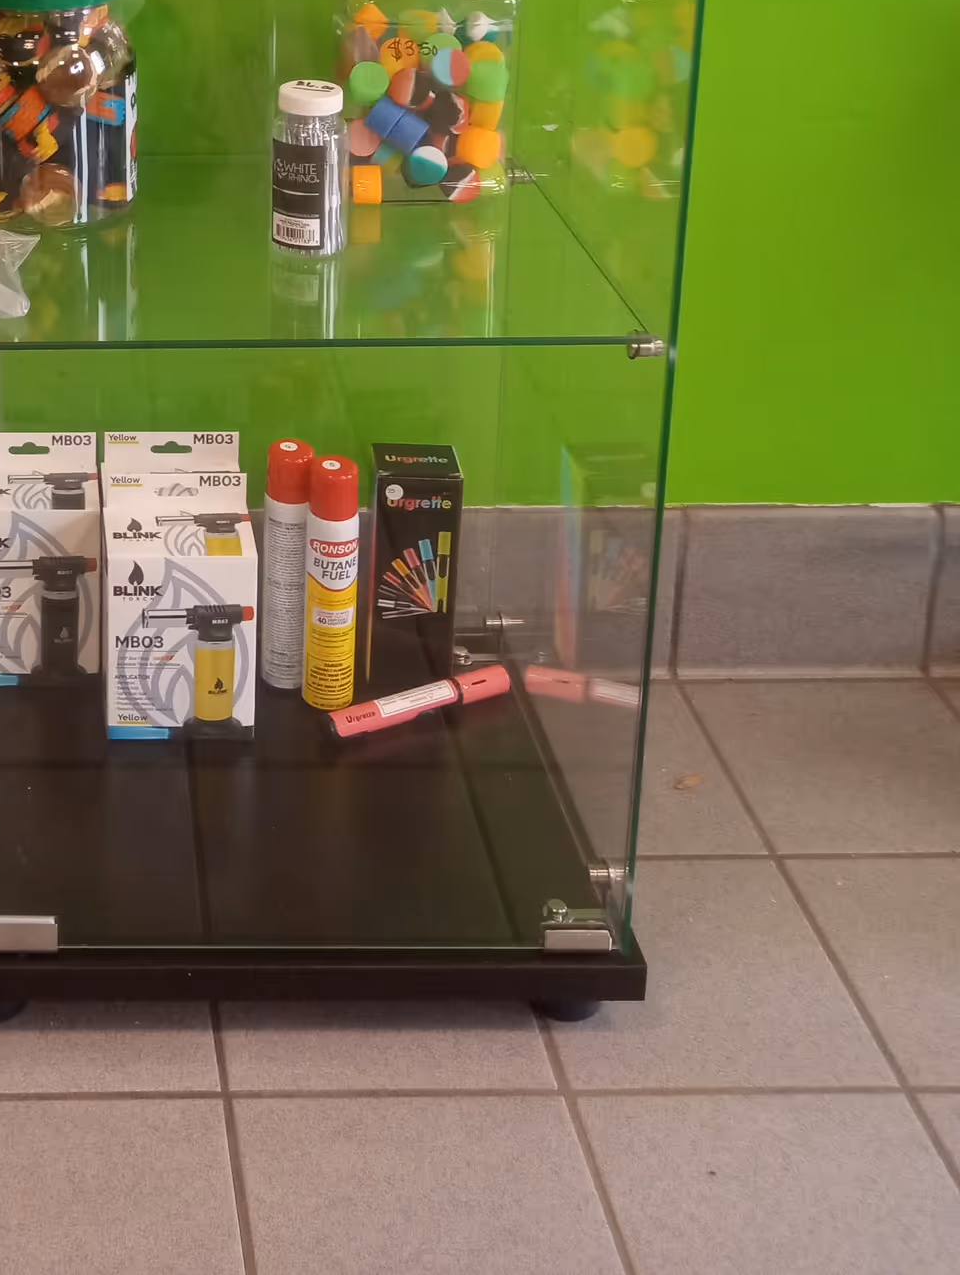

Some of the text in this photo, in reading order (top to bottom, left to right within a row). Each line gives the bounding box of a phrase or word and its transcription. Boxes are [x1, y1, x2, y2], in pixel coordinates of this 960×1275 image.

[284, 163, 317, 175] WHITE
[385, 454, 448, 463] Urgrette
[111, 476, 140, 484] Yellow
[387, 496, 452, 511] Urgrette
[112, 531, 161, 539] BLINK
[312, 539, 359, 555] RONSON
[313, 556, 357, 571] BUTANE
[321, 569, 351, 581] FUEL
[113, 585, 162, 596] BLINK
[118, 713, 148, 721] Yellow
[345, 711, 376, 723] Urgrette
